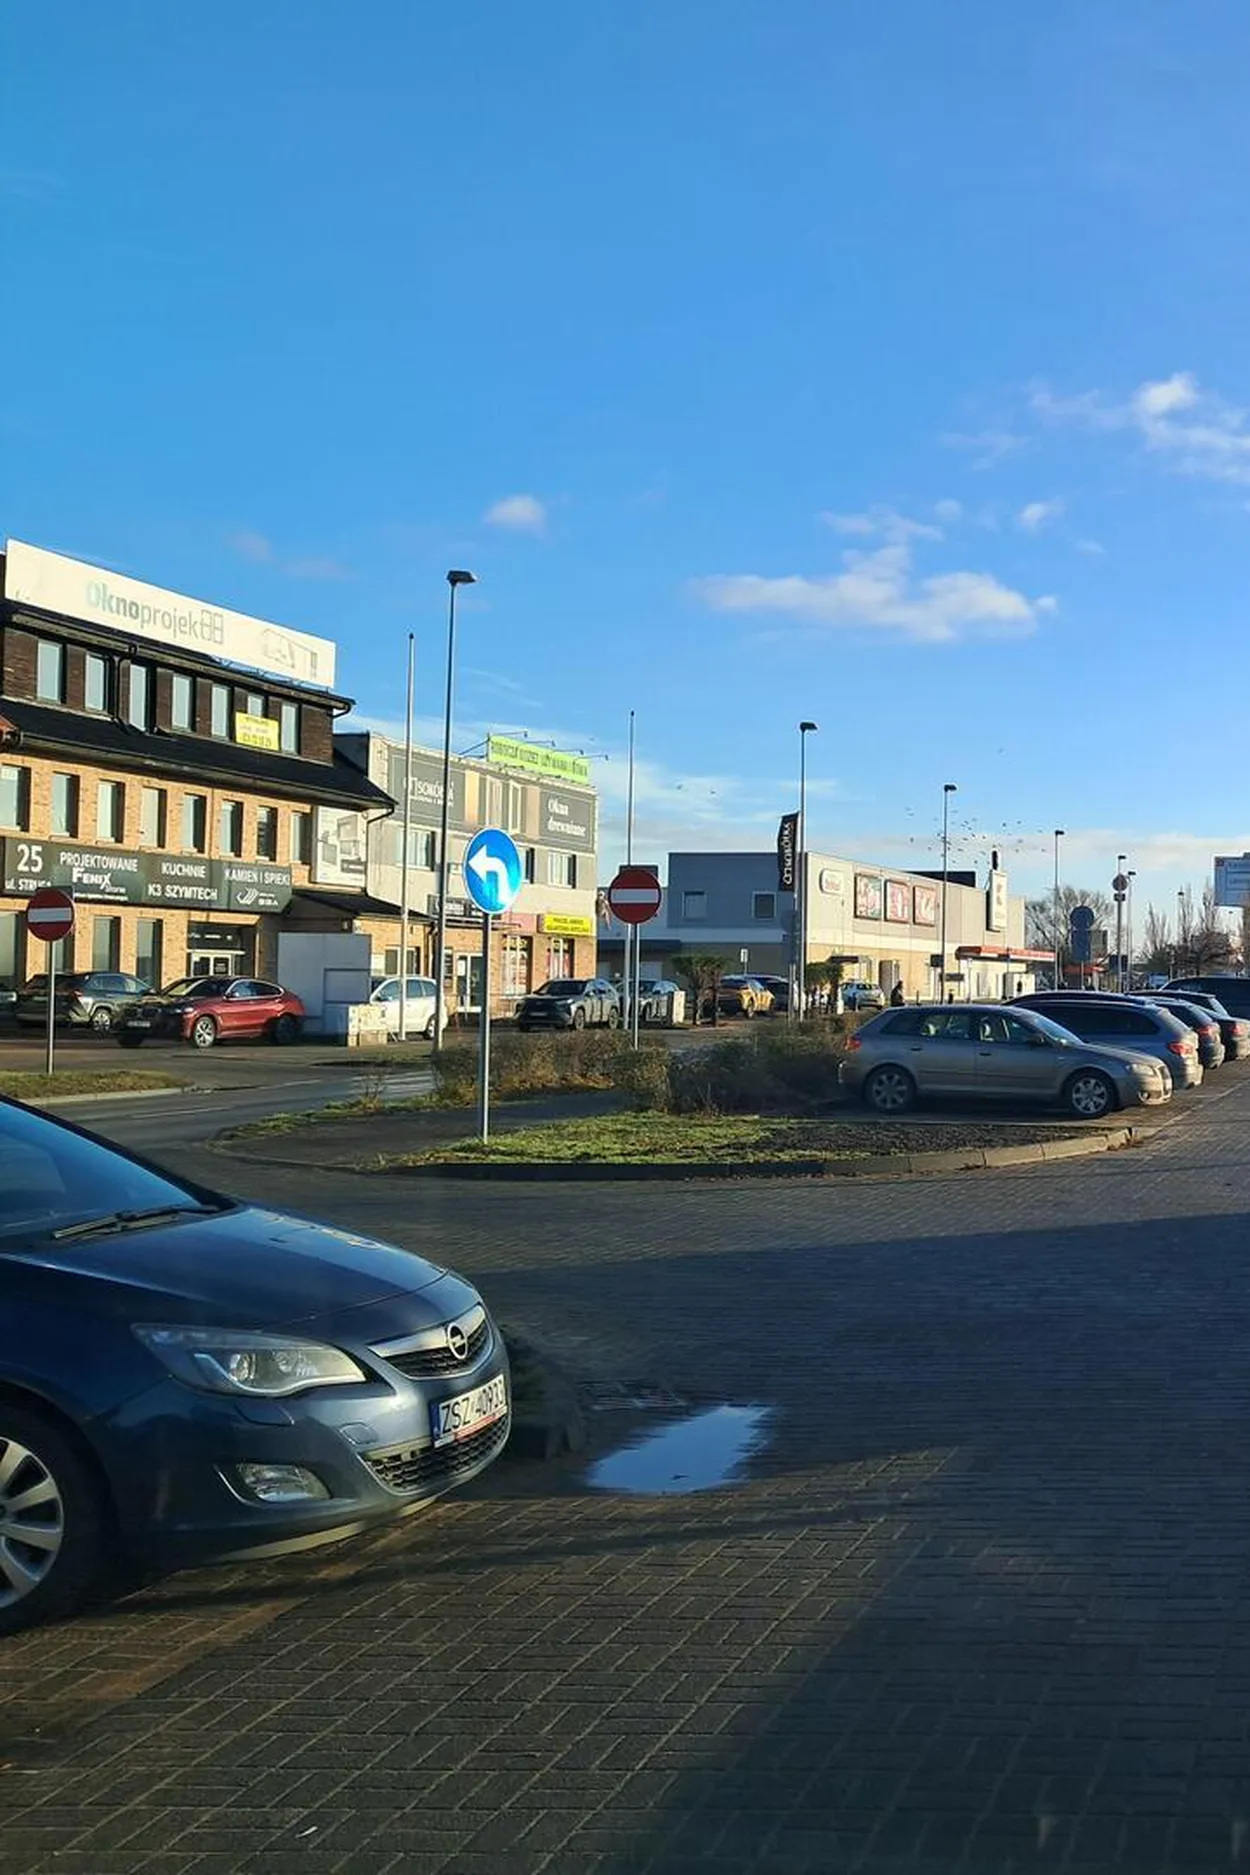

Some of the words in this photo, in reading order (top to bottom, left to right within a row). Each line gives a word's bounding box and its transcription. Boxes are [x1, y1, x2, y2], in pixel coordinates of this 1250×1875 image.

[16, 844, 43, 873] 25
[60, 851, 138, 872] PROJEKTOWANIE
[161, 862, 206, 878] KUCHNIE
[147, 883, 162, 897] K3
[165, 884, 218, 900] SZYMTECH
[441, 1396, 471, 1434] ZSZ
